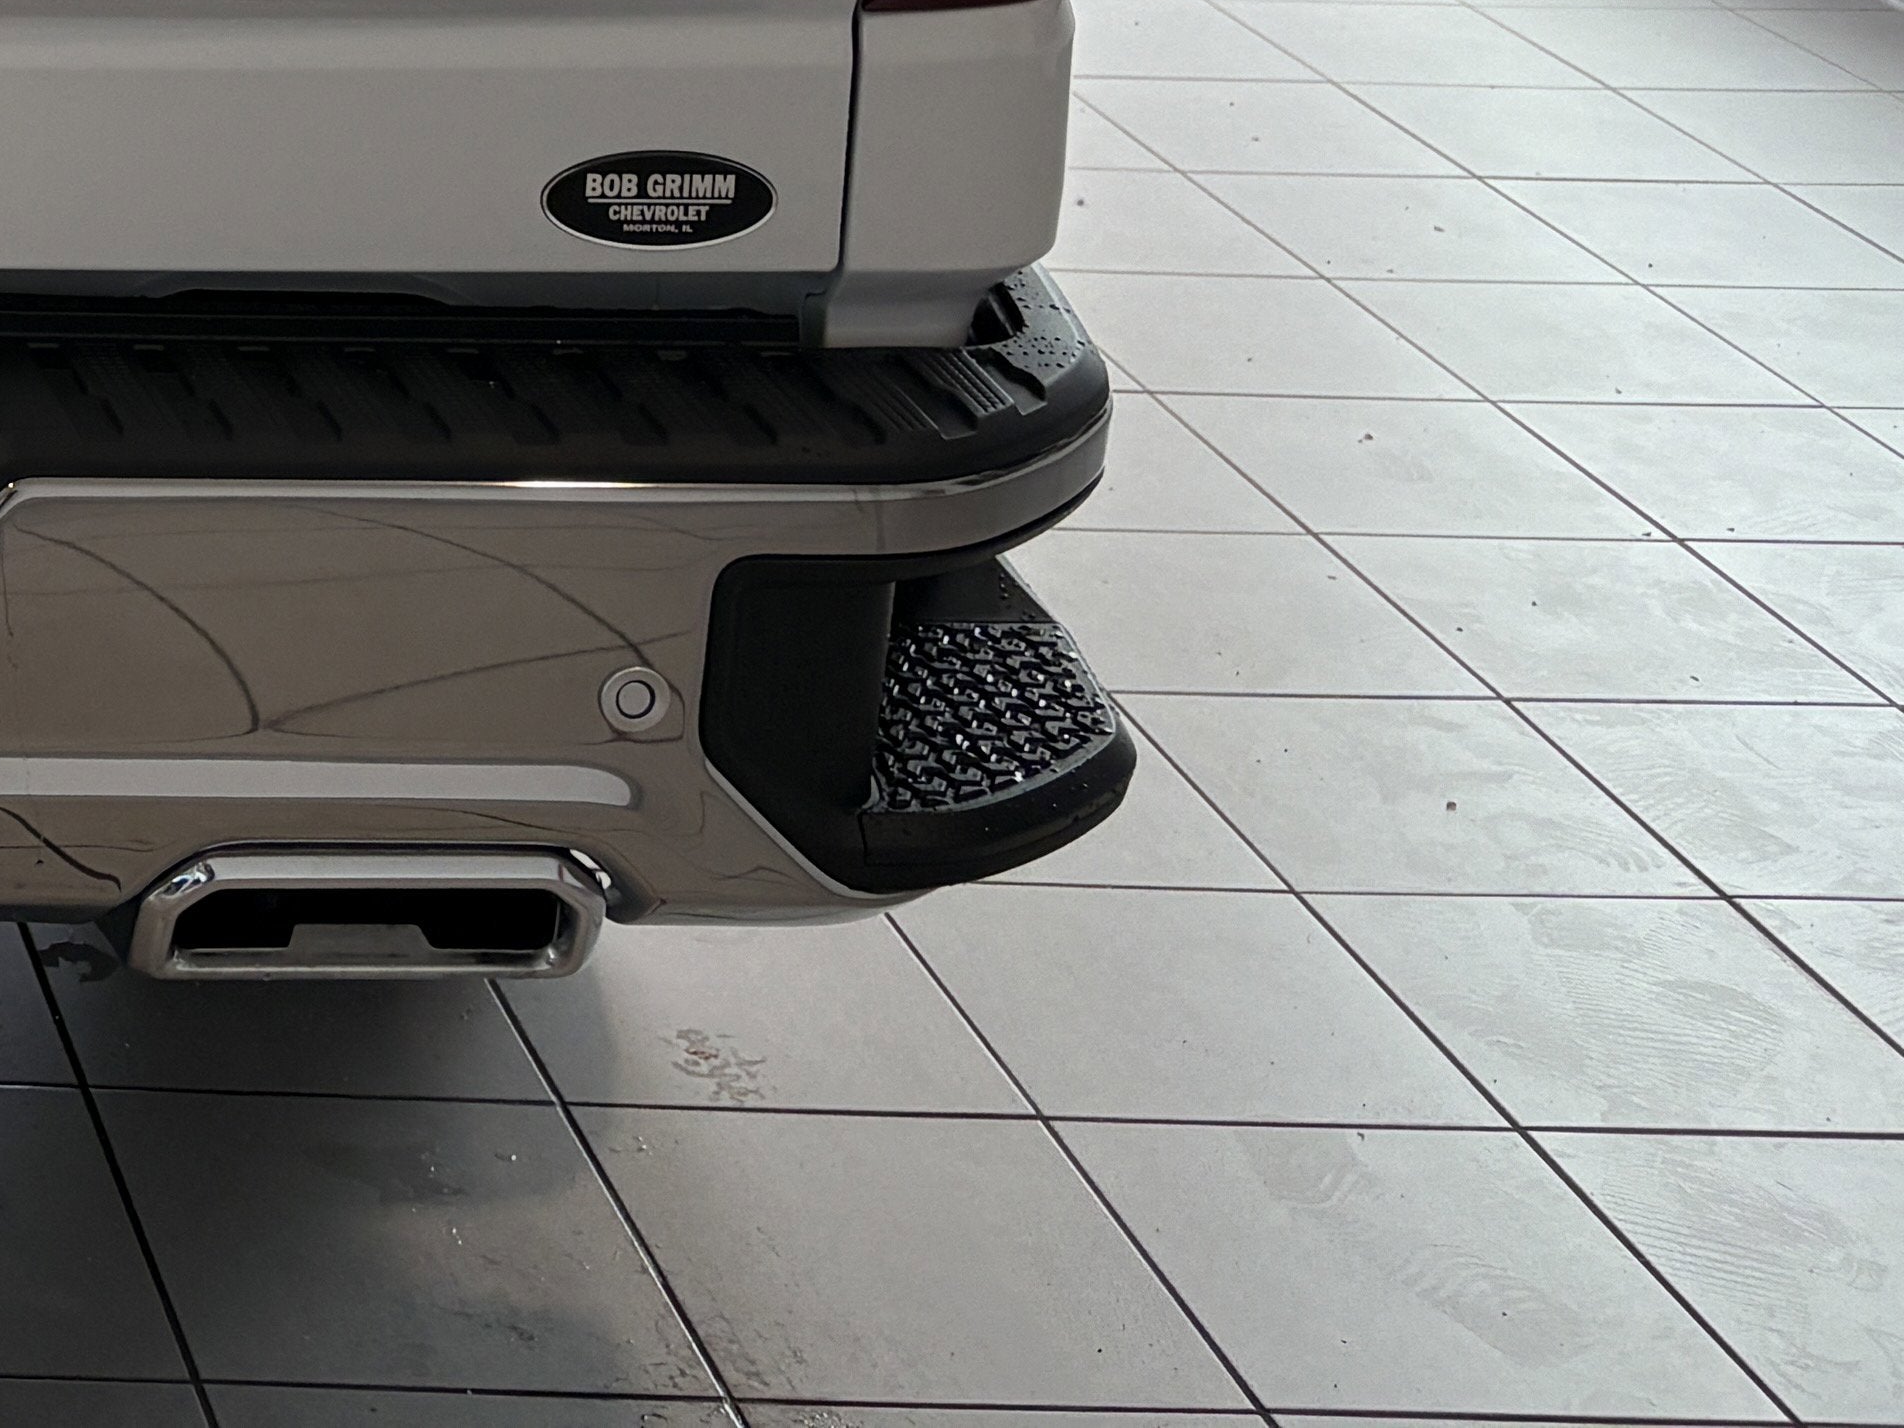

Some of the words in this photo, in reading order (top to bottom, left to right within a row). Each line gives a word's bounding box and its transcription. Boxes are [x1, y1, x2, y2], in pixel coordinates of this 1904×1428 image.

[585, 173, 638, 198] BOB
[646, 173, 736, 198] GRIMM
[608, 205, 710, 221] CHEVROLET
[623, 224, 678, 233] MORTON,
[682, 224, 693, 232] IL
